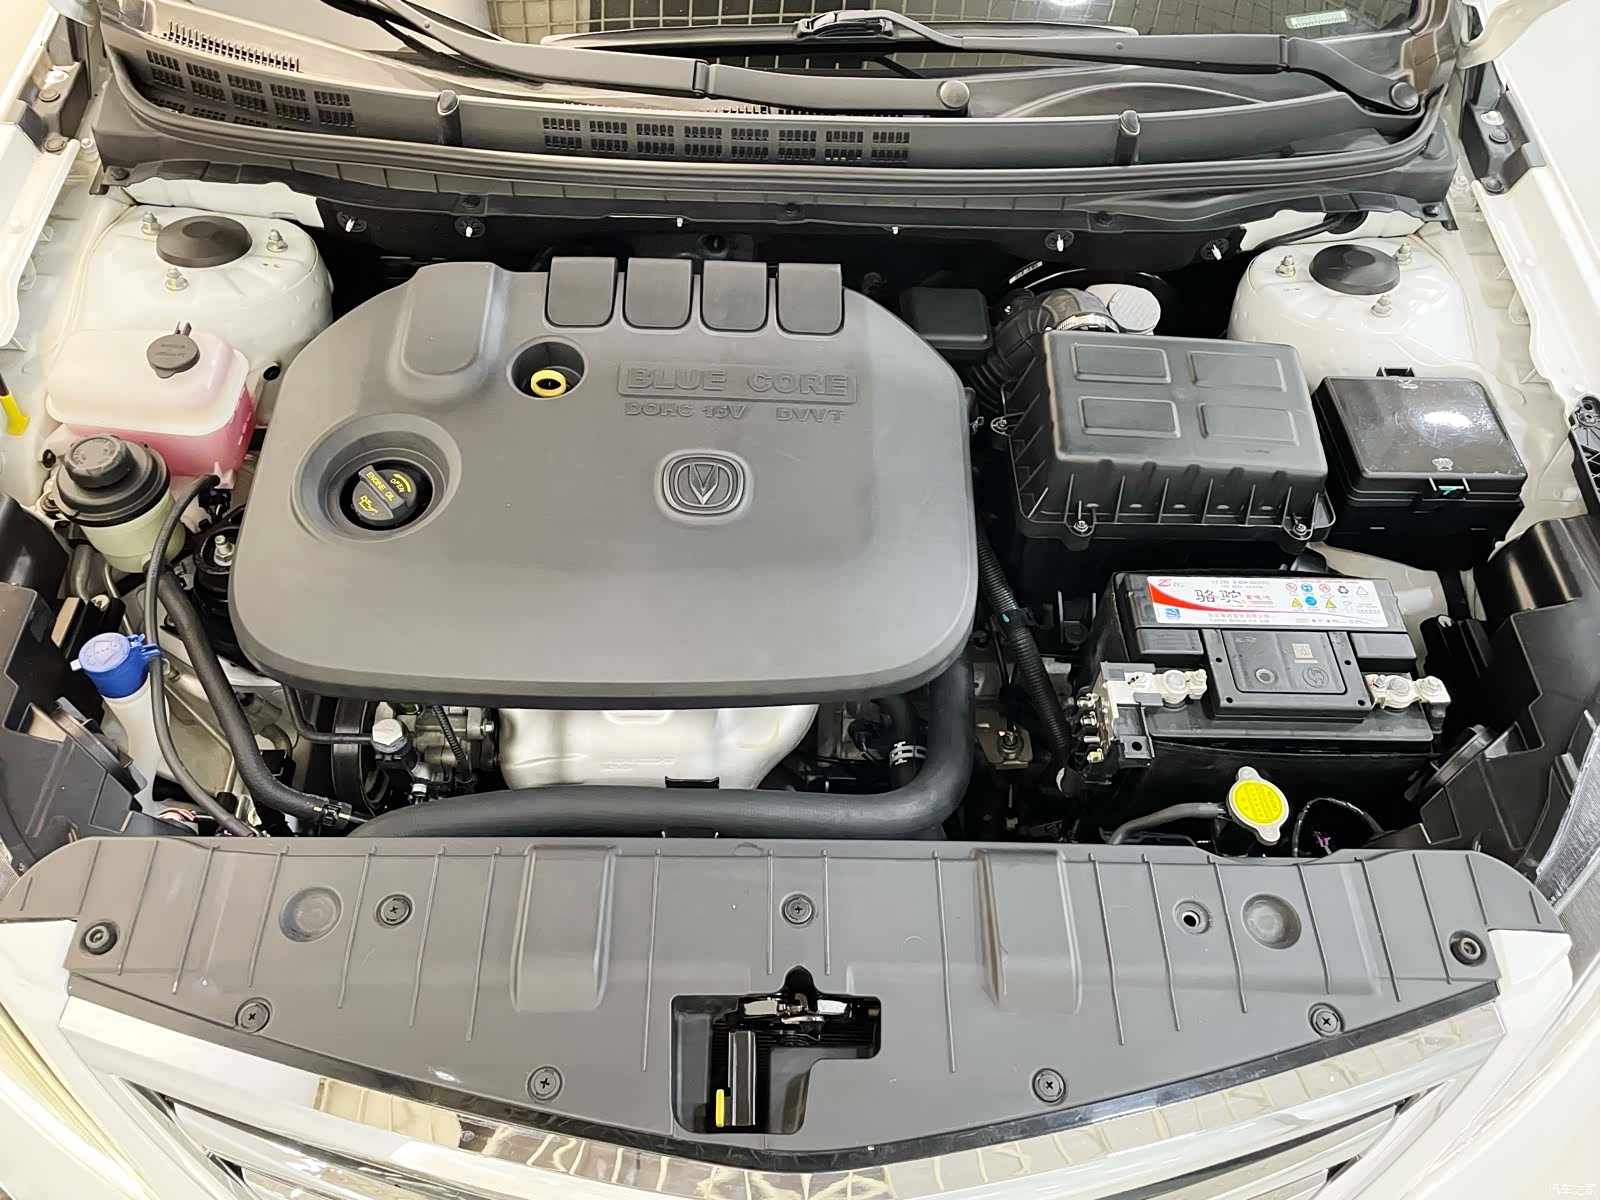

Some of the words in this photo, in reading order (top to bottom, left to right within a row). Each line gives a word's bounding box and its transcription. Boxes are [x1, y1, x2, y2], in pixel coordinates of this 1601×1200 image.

[627, 367, 728, 391] BLUE
[747, 372, 849, 396] CORE
[624, 402, 695, 417] DOHC
[702, 405, 746, 419] 16V
[776, 407, 847, 423] DVVT
[366, 471, 386, 491] ENGINE
[385, 491, 395, 501] OIL
[390, 478, 405, 492] OPEN
